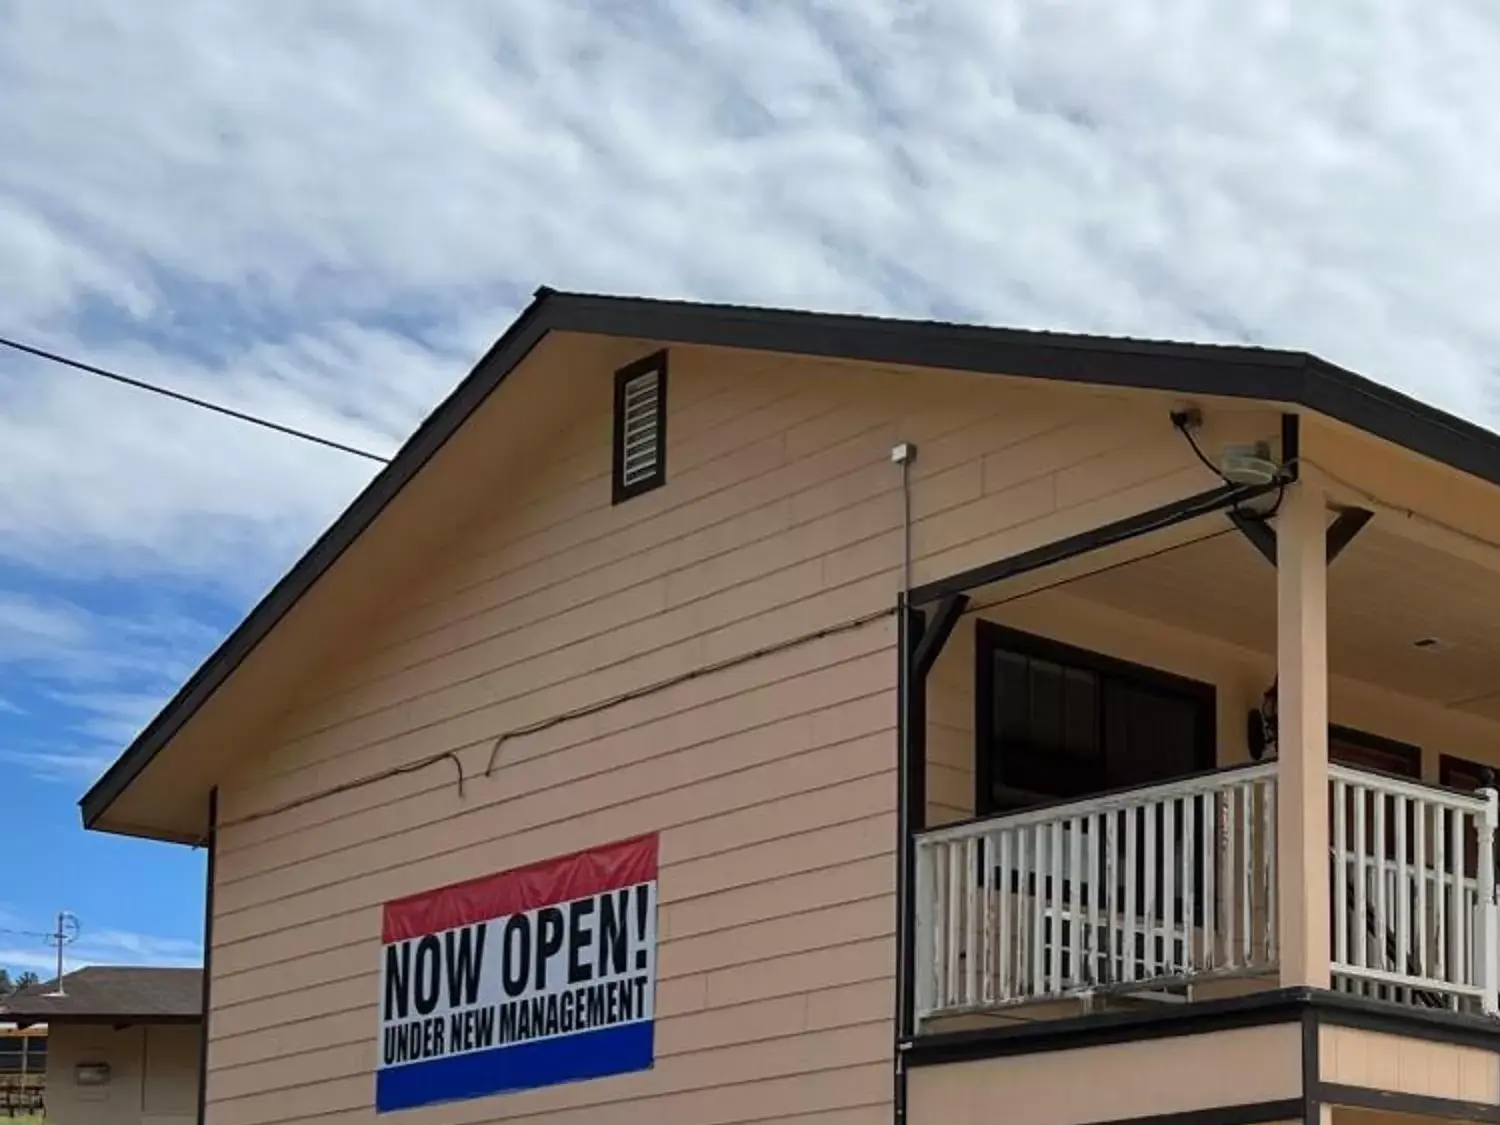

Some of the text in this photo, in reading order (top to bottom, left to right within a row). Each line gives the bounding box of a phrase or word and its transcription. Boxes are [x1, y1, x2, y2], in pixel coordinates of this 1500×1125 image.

[384, 884, 649, 1021] NOW OPEN!
[383, 976, 648, 1065] UNDER NEW MANAGEMENT
